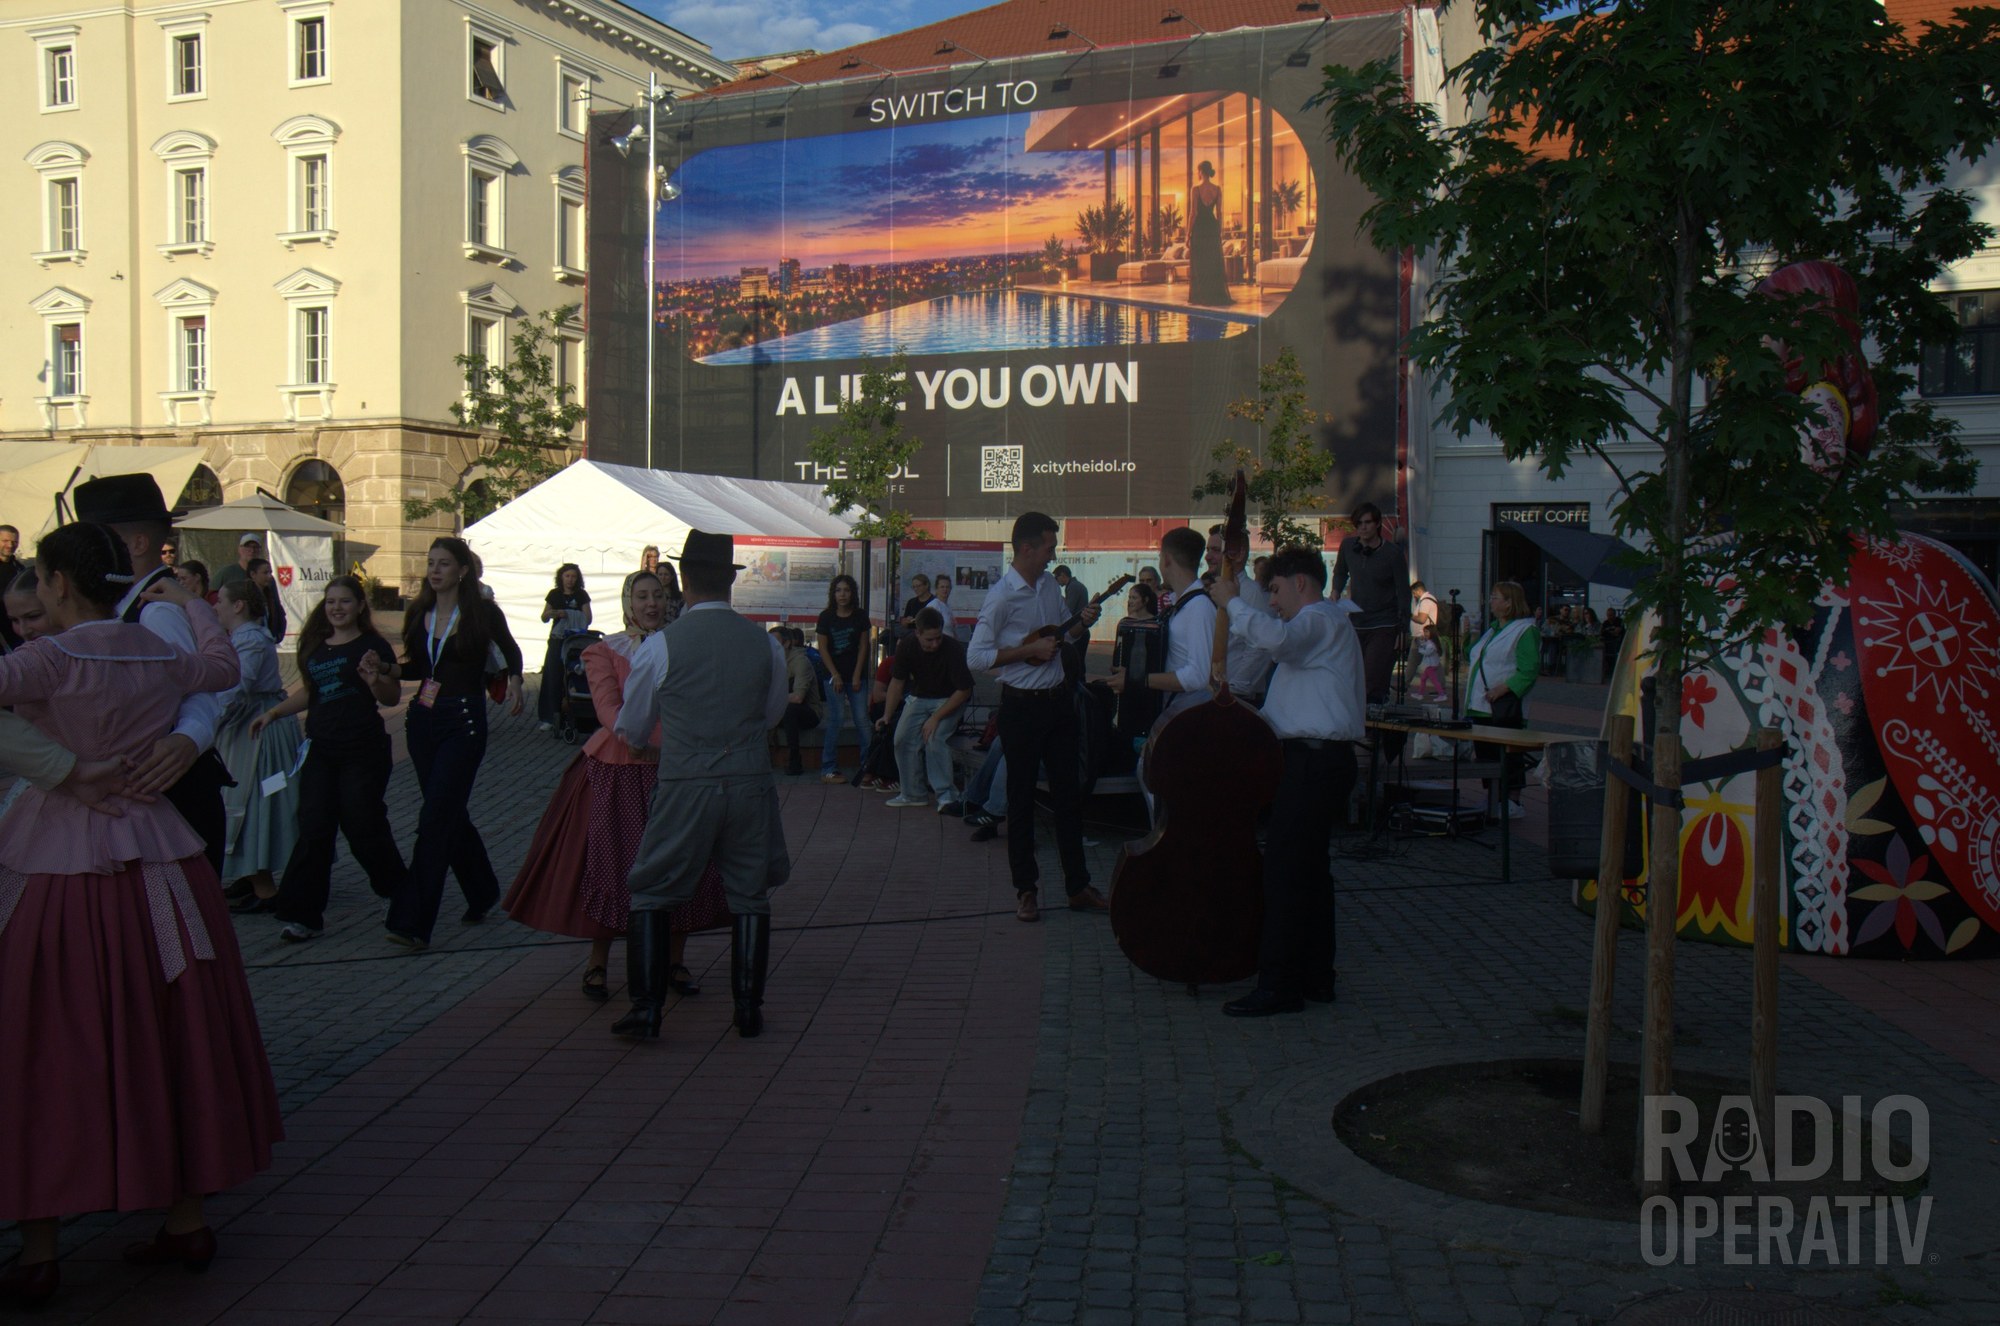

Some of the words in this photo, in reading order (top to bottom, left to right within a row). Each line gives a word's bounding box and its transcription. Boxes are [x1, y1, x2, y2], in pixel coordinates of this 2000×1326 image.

[870, 86, 986, 123] SWITCH
[996, 80, 1037, 108] TO
[776, 377, 806, 416] A
[915, 366, 1010, 410] YOU
[1020, 361, 1138, 407] OWN
[794, 461, 848, 481] THE
[1032, 459, 1137, 476] xcitytheidol.ro
[1500, 510, 1541, 523] STREET
